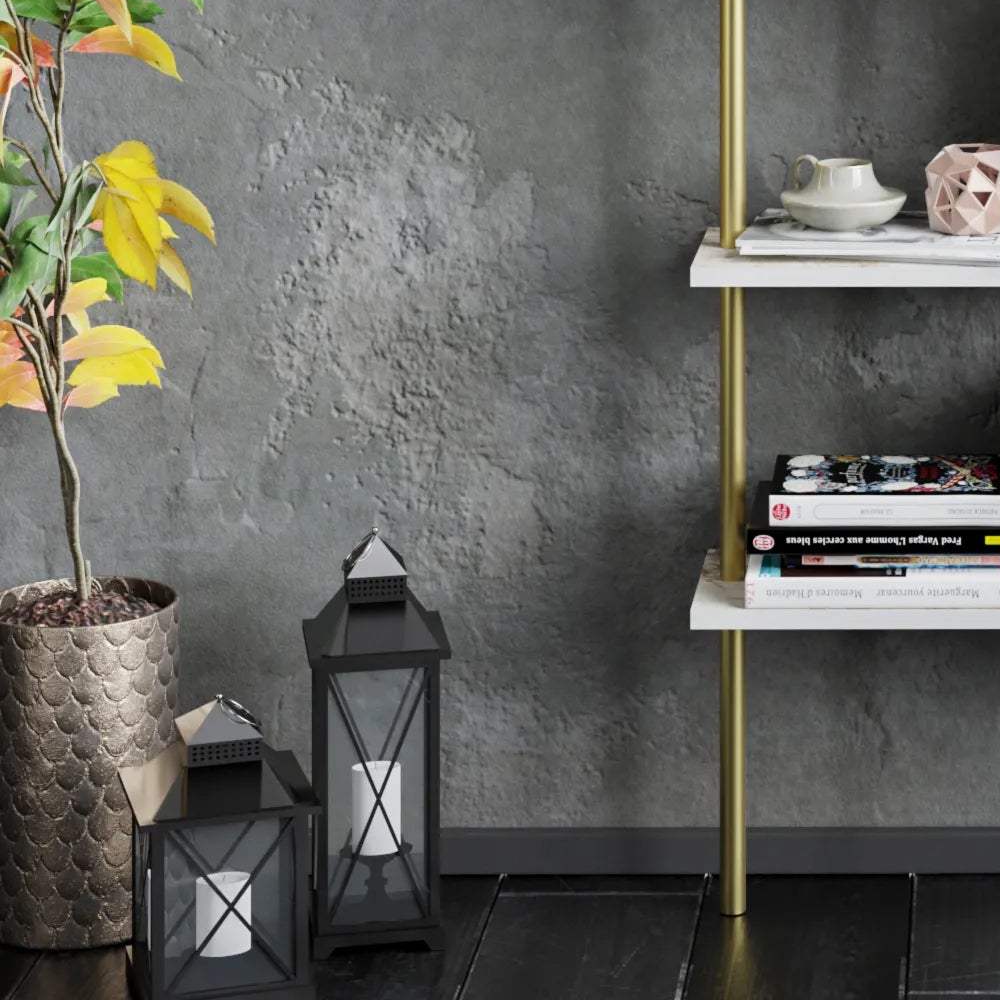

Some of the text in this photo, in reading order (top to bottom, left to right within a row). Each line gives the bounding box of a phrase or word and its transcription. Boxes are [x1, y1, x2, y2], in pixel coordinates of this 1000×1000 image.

[785, 535, 811, 546] bleus
[813, 536, 845, 546] cercles
[846, 536, 864, 545] aux
[865, 536, 907, 546] L'homme
[908, 534, 939, 546] Vargas
[940, 536, 962, 546] Fred
[765, 588, 813, 599] d'Hadrien
[876, 587, 926, 598] yourcenar
[927, 588, 980, 599] Marguerite
